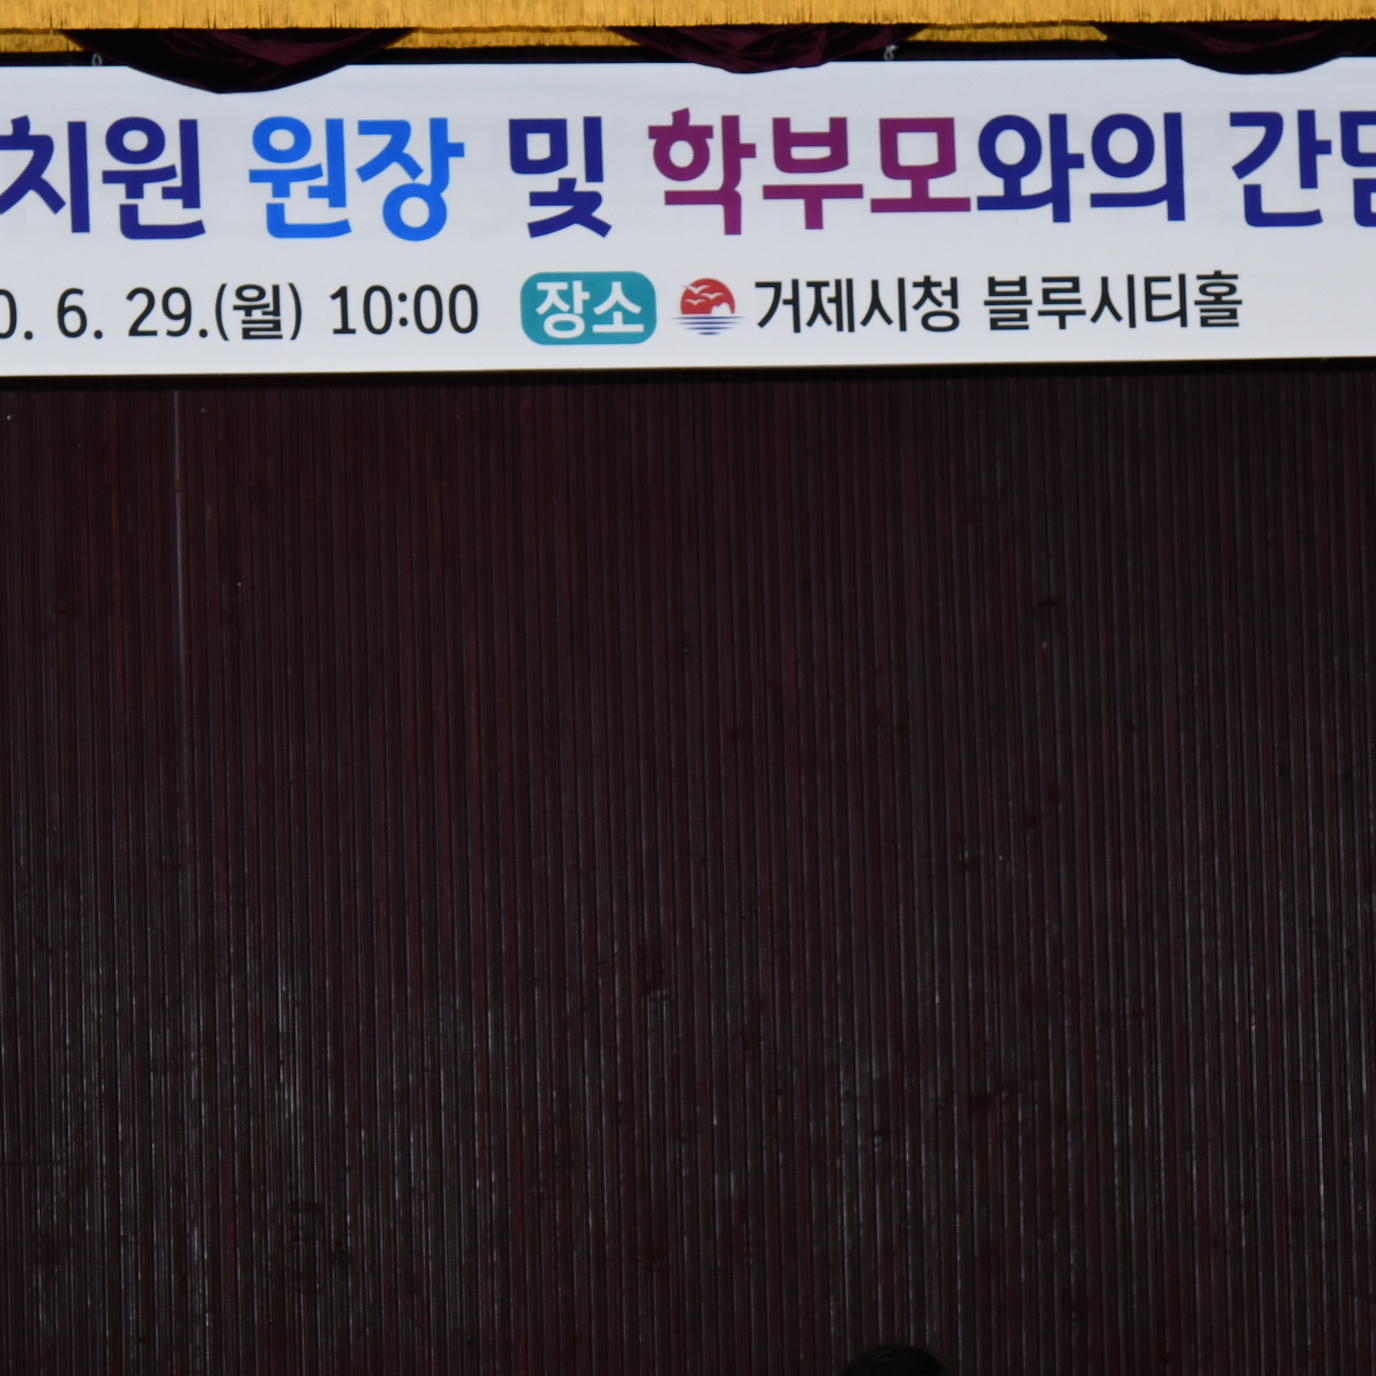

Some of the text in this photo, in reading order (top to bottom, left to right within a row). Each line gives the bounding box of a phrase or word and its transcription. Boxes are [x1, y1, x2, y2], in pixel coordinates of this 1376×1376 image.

[249, 115, 465, 241] 원장
[508, 115, 612, 238] 및
[647, 107, 1186, 235] 학부모와의
[56, 286, 104, 341] 6.
[125, 282, 303, 342] 29.(월)
[329, 283, 480, 336] 10:00
[535, 278, 645, 339] 장소
[754, 275, 961, 334] 거제시청
[983, 270, 1244, 331] 블루시티홀
